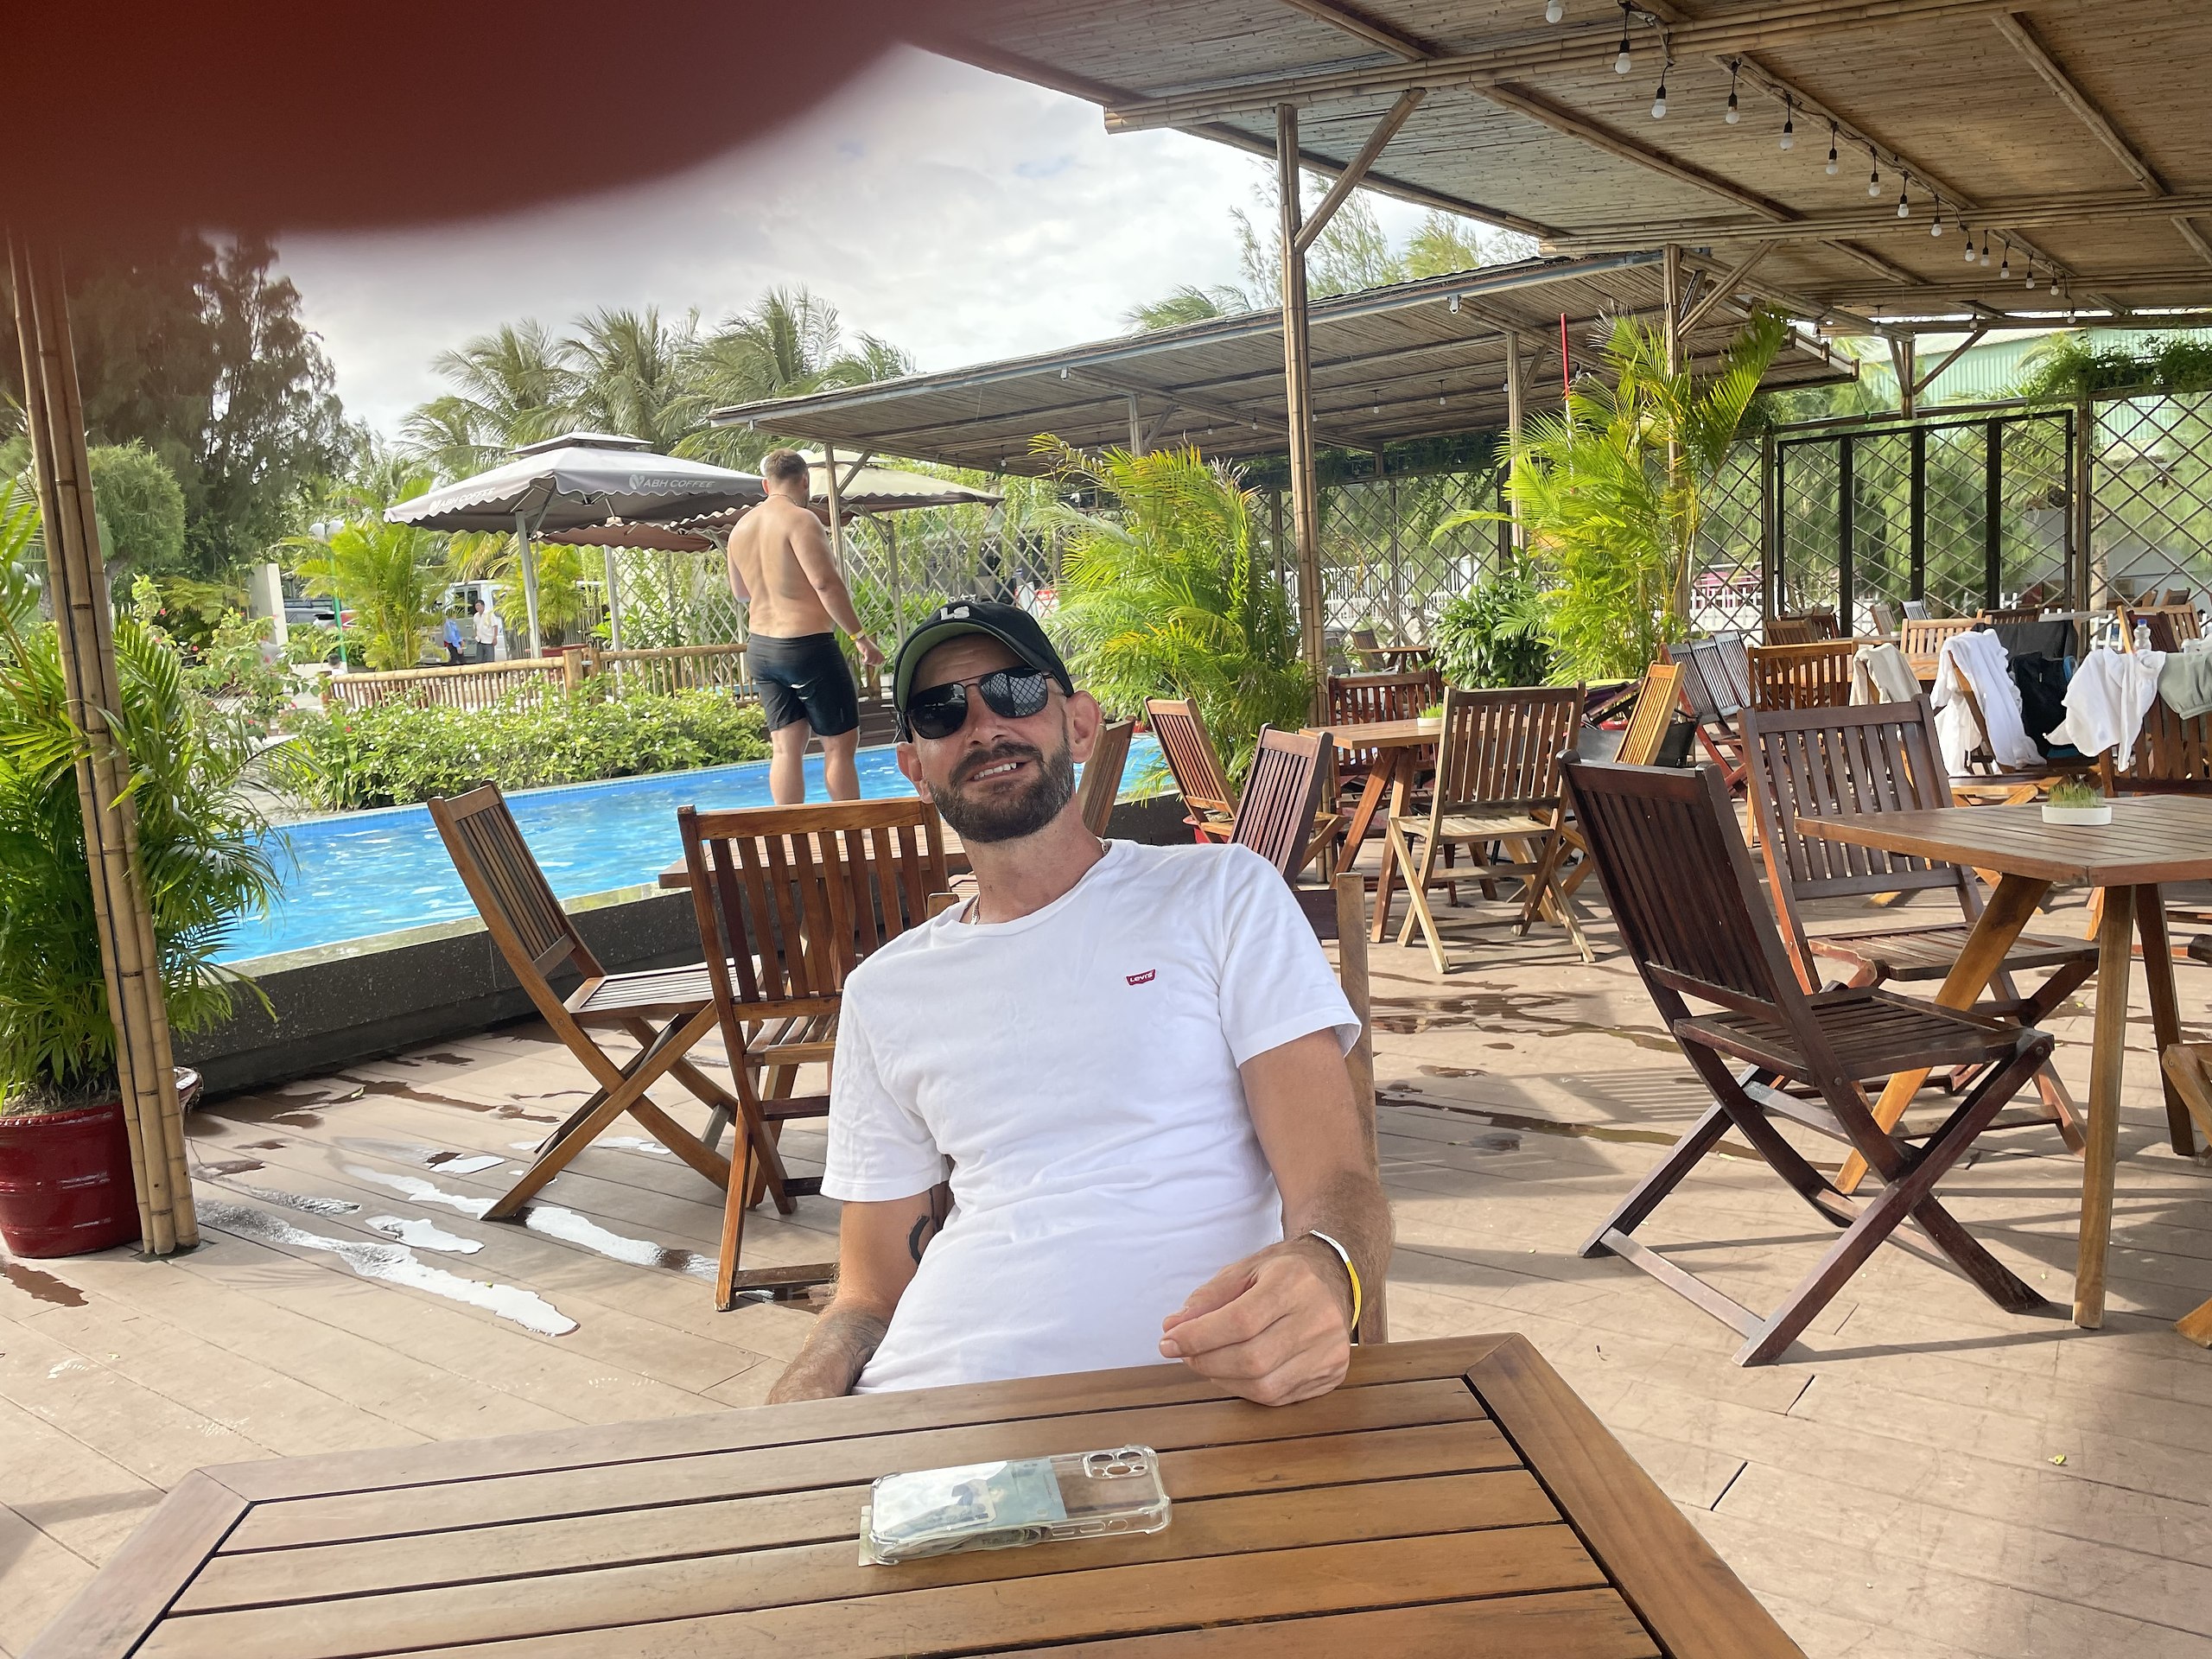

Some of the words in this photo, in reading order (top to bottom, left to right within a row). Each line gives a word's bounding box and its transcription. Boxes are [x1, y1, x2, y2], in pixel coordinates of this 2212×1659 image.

[644, 479, 669, 487] ABH
[670, 480, 715, 488] COFFEE
[459, 488, 495, 502] COFFEE
